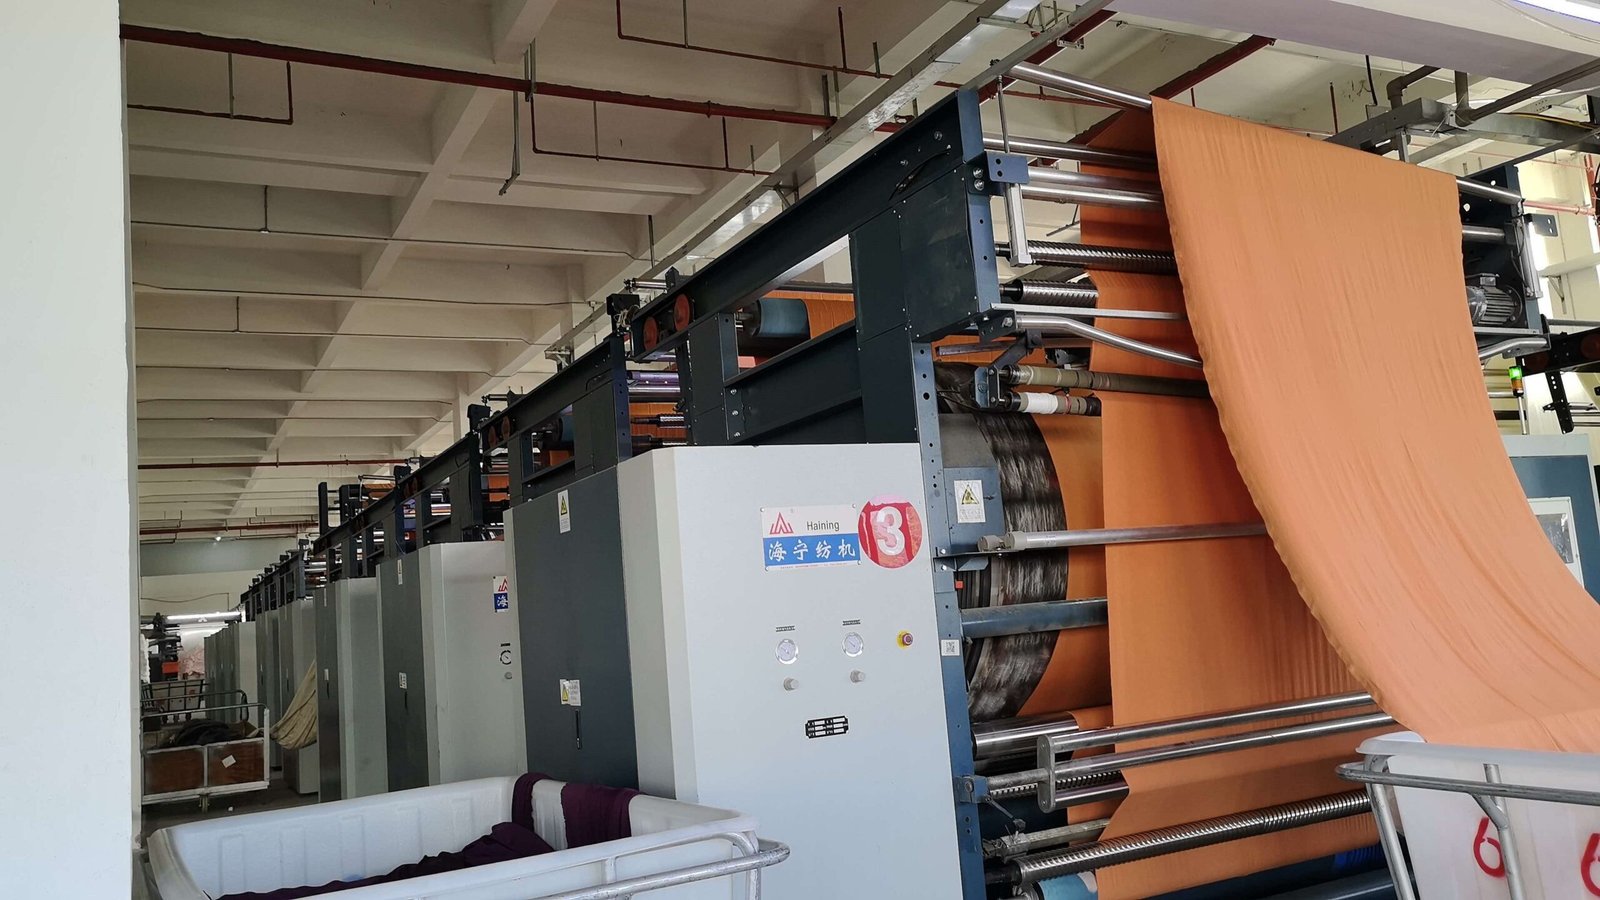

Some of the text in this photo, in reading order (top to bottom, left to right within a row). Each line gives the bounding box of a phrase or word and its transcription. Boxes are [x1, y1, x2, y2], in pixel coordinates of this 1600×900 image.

[806, 521, 840, 532] Haining
[876, 506, 905, 556] 3
[768, 538, 856, 562] 海宁纺机
[1473, 816, 1506, 878] 6
